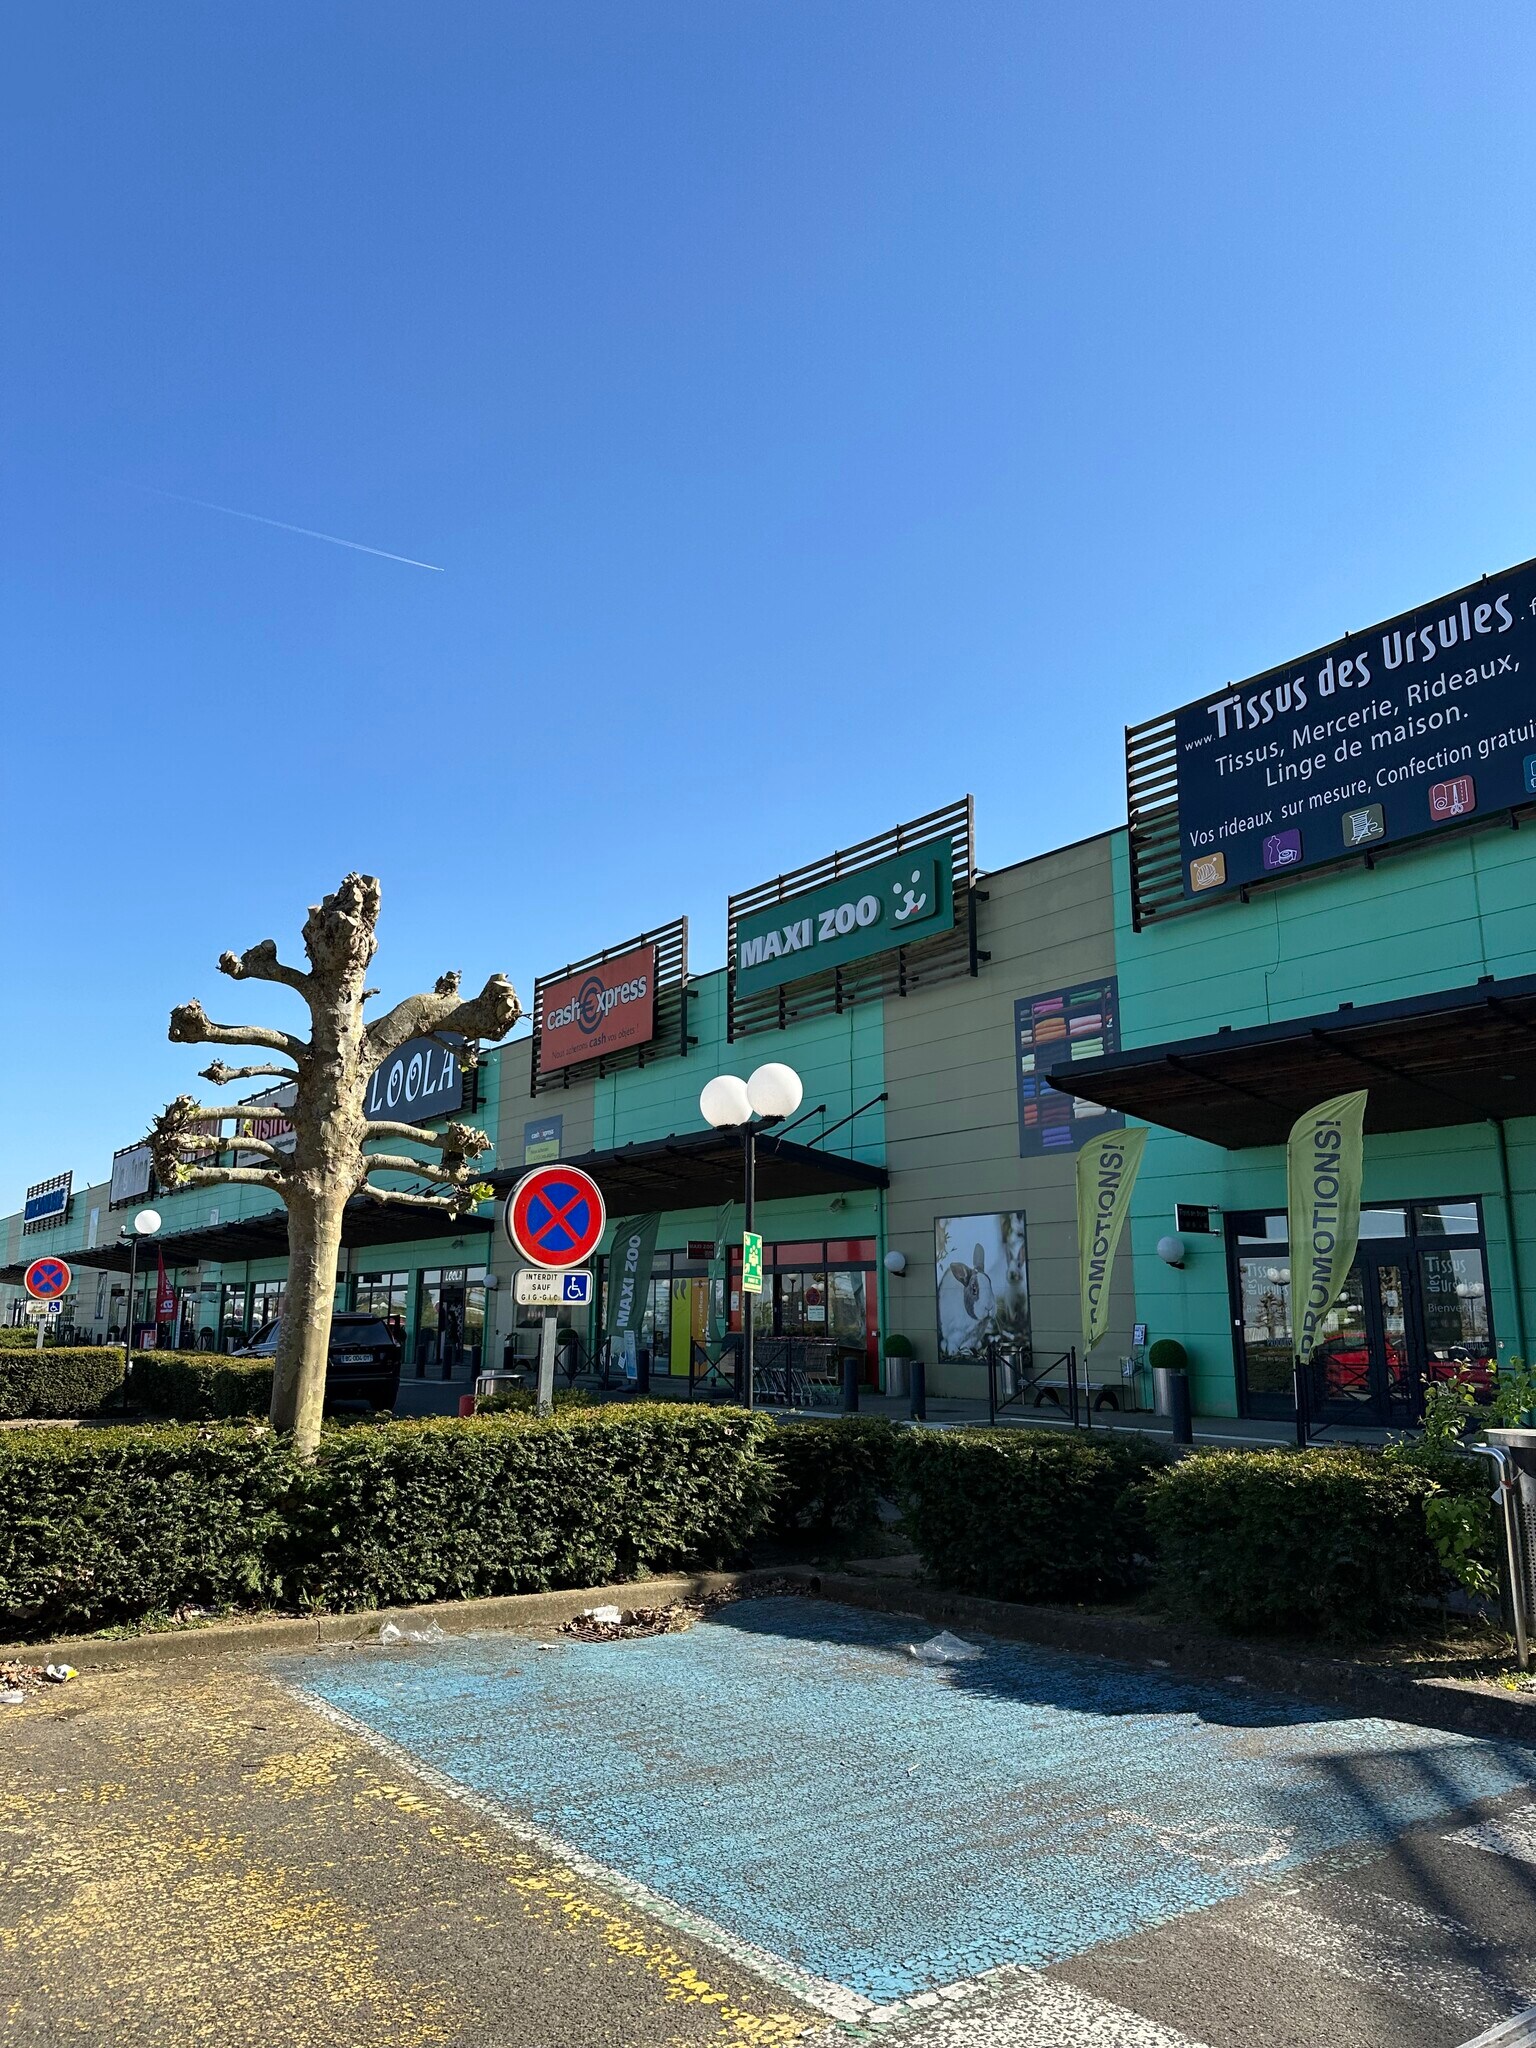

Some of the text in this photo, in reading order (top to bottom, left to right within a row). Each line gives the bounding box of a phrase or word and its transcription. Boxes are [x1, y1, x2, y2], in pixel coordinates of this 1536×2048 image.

[1207, 676, 1307, 738] Tissus
[1318, 651, 1371, 697] des
[1382, 593, 1513, 670] Ursules
[1215, 654, 1520, 776] Tissus, Mercerie, Rideaux,
[1266, 706, 1469, 787] Linge de maison.
[1190, 719, 1536, 847] Vos rideaux sur mesure, Confection gratui
[741, 895, 881, 969] MAXI ZOO
[589, 1032, 607, 1048] cash
[370, 1048, 455, 1114] LOOLA
[525, 1273, 558, 1281] INTERDIT
[532, 1283, 552, 1291] SAUF
[616, 1234, 642, 1327] MAXI ZOO
[1425, 1256, 1467, 1274] Tissus
[1427, 1275, 1441, 1293] des
